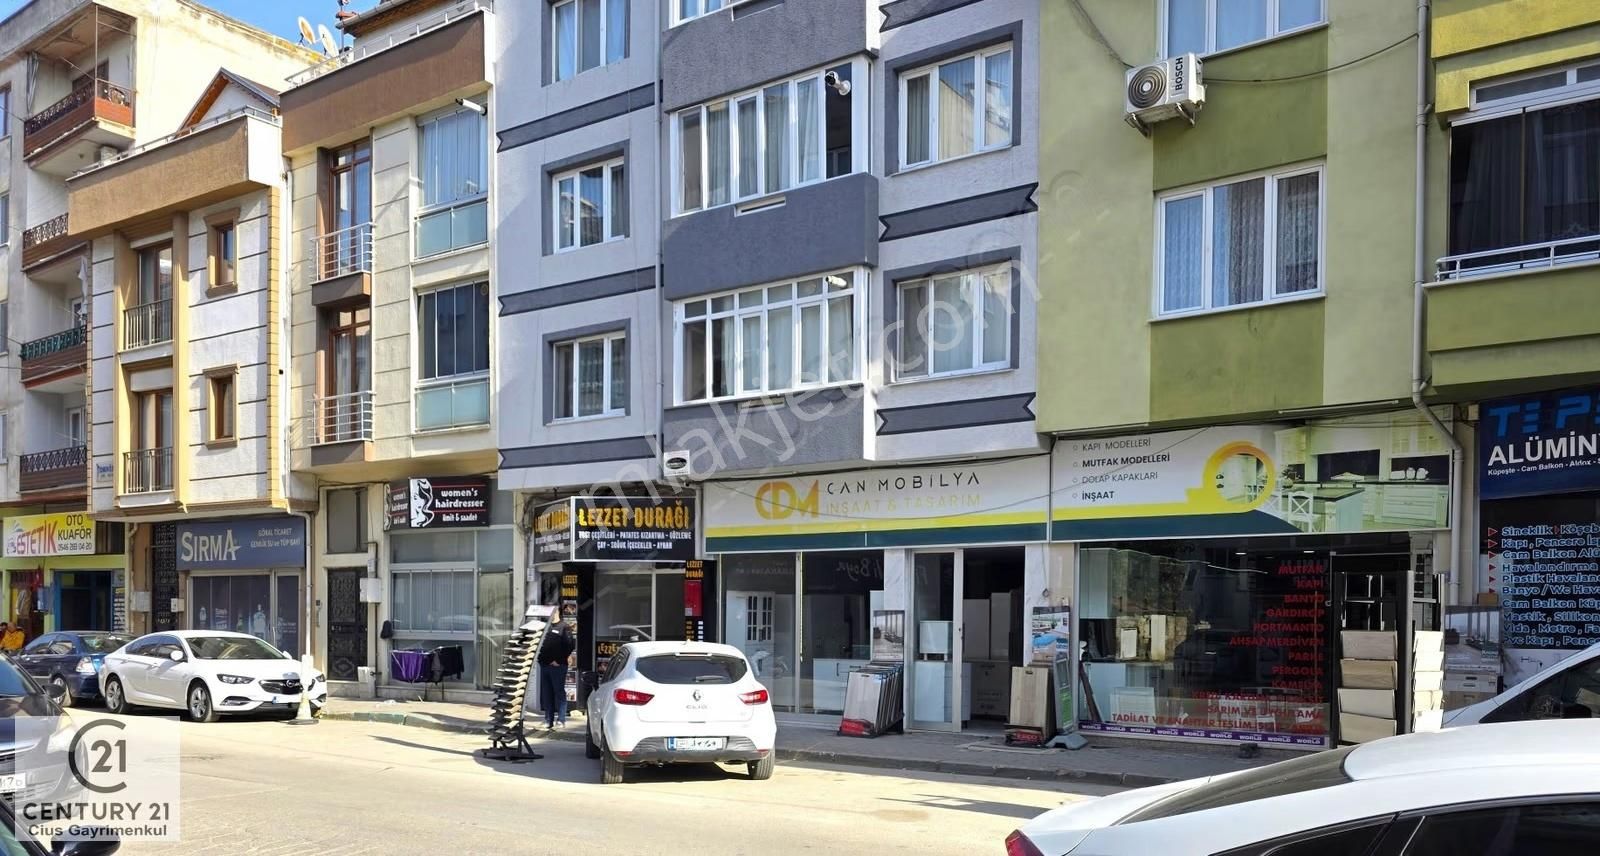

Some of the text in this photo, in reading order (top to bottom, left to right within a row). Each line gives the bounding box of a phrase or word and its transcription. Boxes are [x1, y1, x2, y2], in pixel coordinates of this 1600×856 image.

[1175, 57, 1183, 91] BOSCH
[1082, 438, 1151, 452] KAPI MODELLERİ
[1082, 453, 1170, 468] MUTFAK MODELLERİ
[1539, 463, 1564, 471] Balkon
[1082, 474, 1109, 484] DOLAP
[441, 487, 478, 497] women's
[827, 480, 866, 495] CAN
[754, 479, 820, 520] CDM
[1082, 490, 1115, 502] İNŞAAT
[435, 499, 485, 508] hairdresser
[578, 507, 629, 528] LEZZET
[634, 499, 689, 530] DURAĞI
[66, 515, 84, 526] OTO
[58, 526, 92, 541] KUAFÖR
[1502, 526, 1553, 536] Sineklik
[181, 529, 241, 562] SIRMA
[1535, 538, 1586, 547] Pencere
[1502, 550, 1530, 559] Cam
[1532, 550, 1577, 559] Balkon
[1502, 562, 1598, 573] Havalandırma
[1502, 573, 1546, 584] Plastik
[1502, 586, 1540, 597] Banyo
[1550, 585, 1571, 594] Wc
[1502, 600, 1529, 609] Cam
[1532, 598, 1577, 608] Balkon
[1538, 623, 1576, 633] Metre
[1112, 711, 1149, 723] TADİLAT
